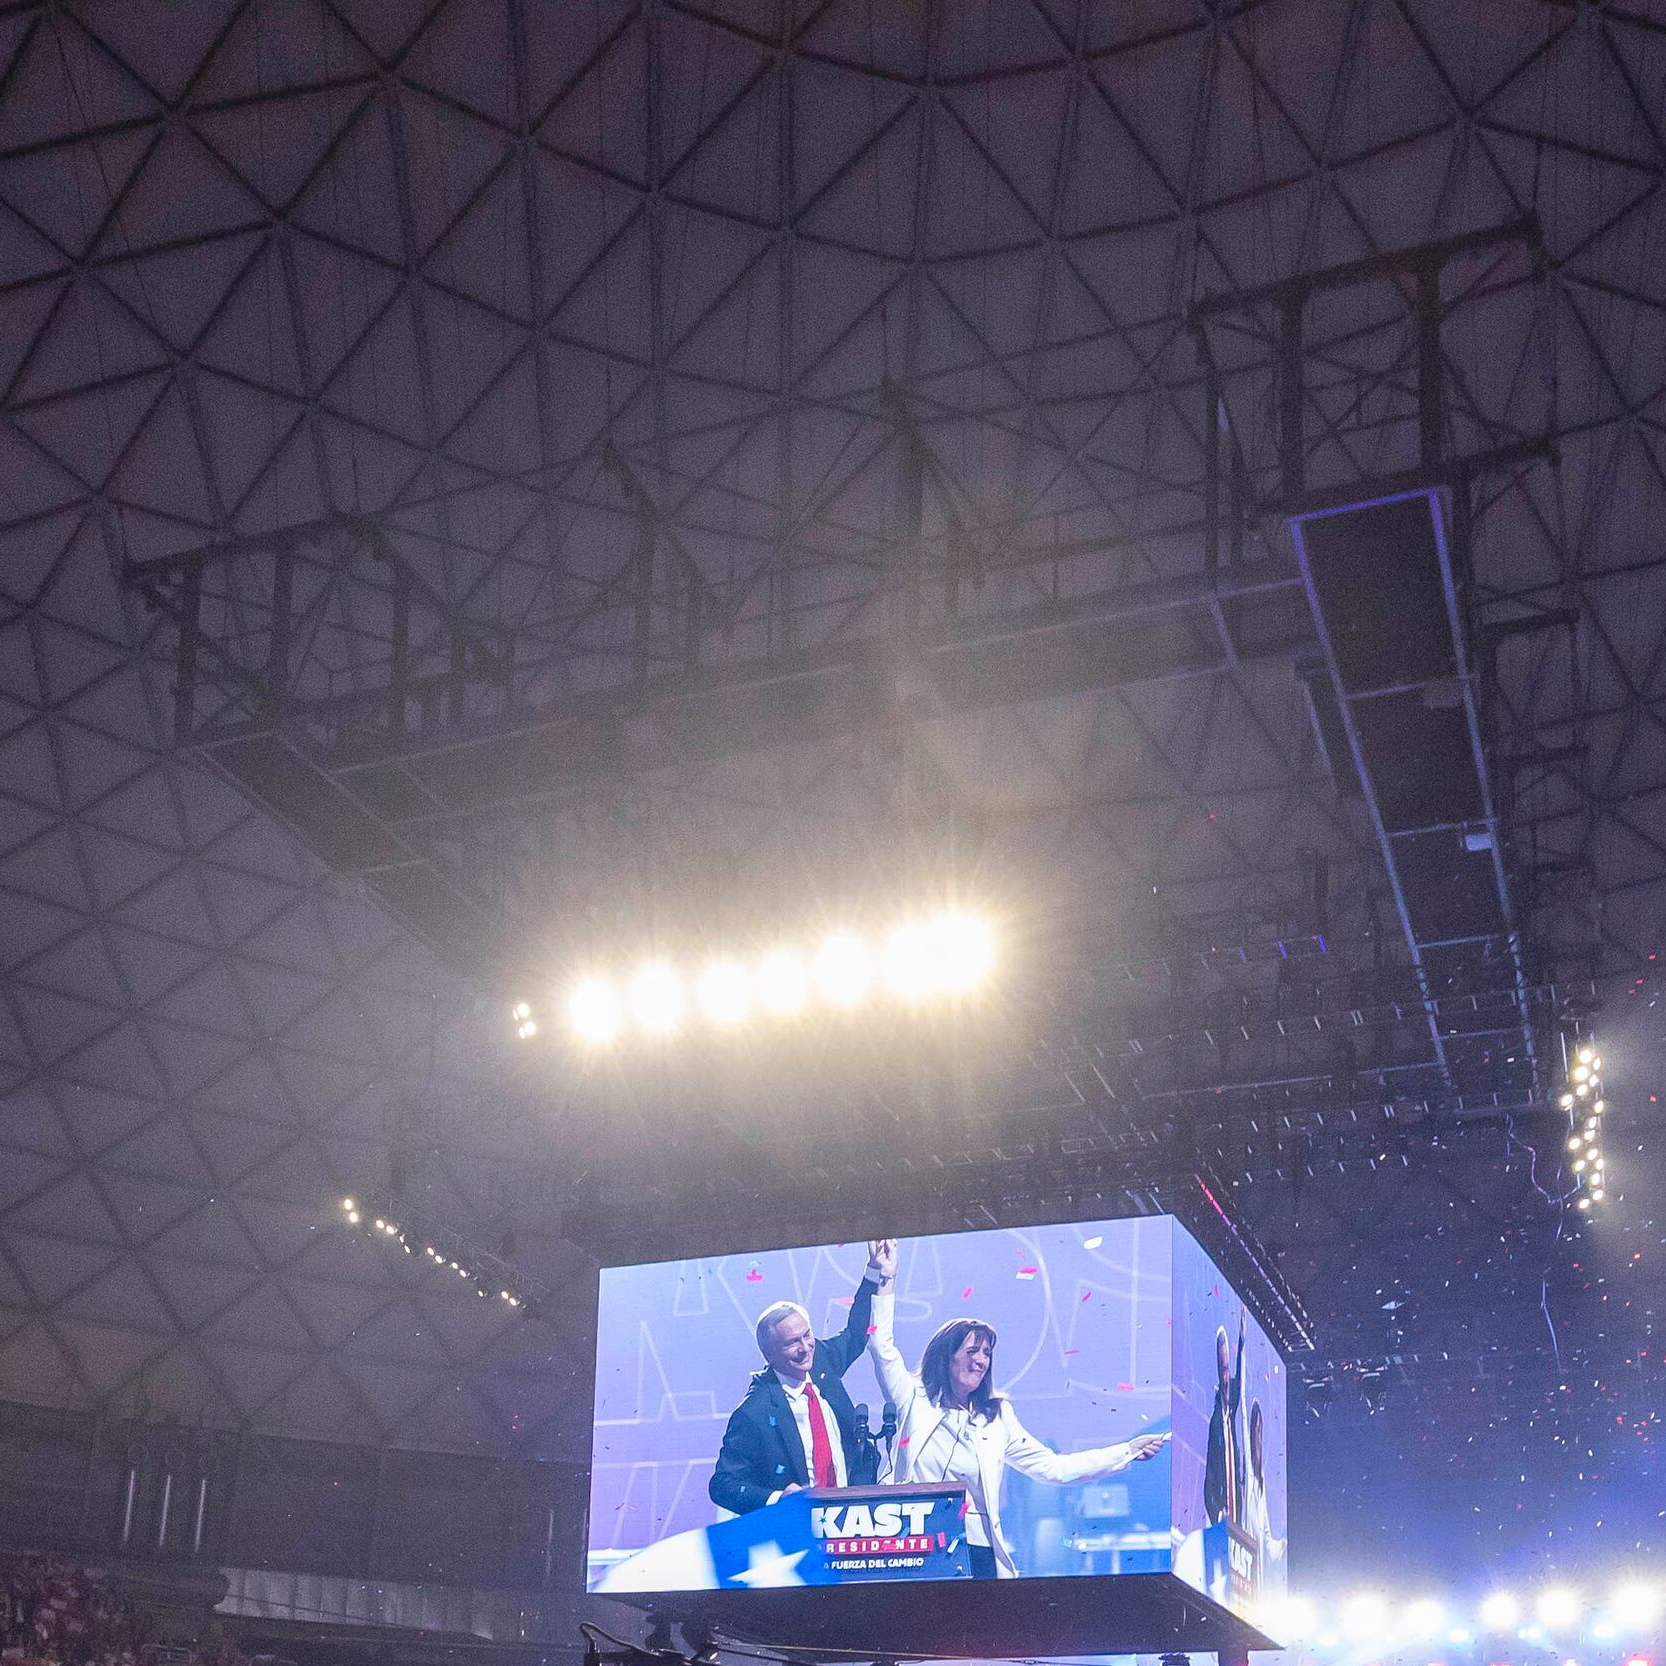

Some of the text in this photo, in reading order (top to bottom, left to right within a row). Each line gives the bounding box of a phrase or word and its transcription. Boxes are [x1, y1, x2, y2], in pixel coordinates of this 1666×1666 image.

[811, 1502, 934, 1539] KAST
[818, 1538, 929, 1554] RESIDNTE
[831, 1560, 866, 1570] FUERZA
[868, 1559, 886, 1568] DEL
[888, 1557, 924, 1567] CAMBIO
